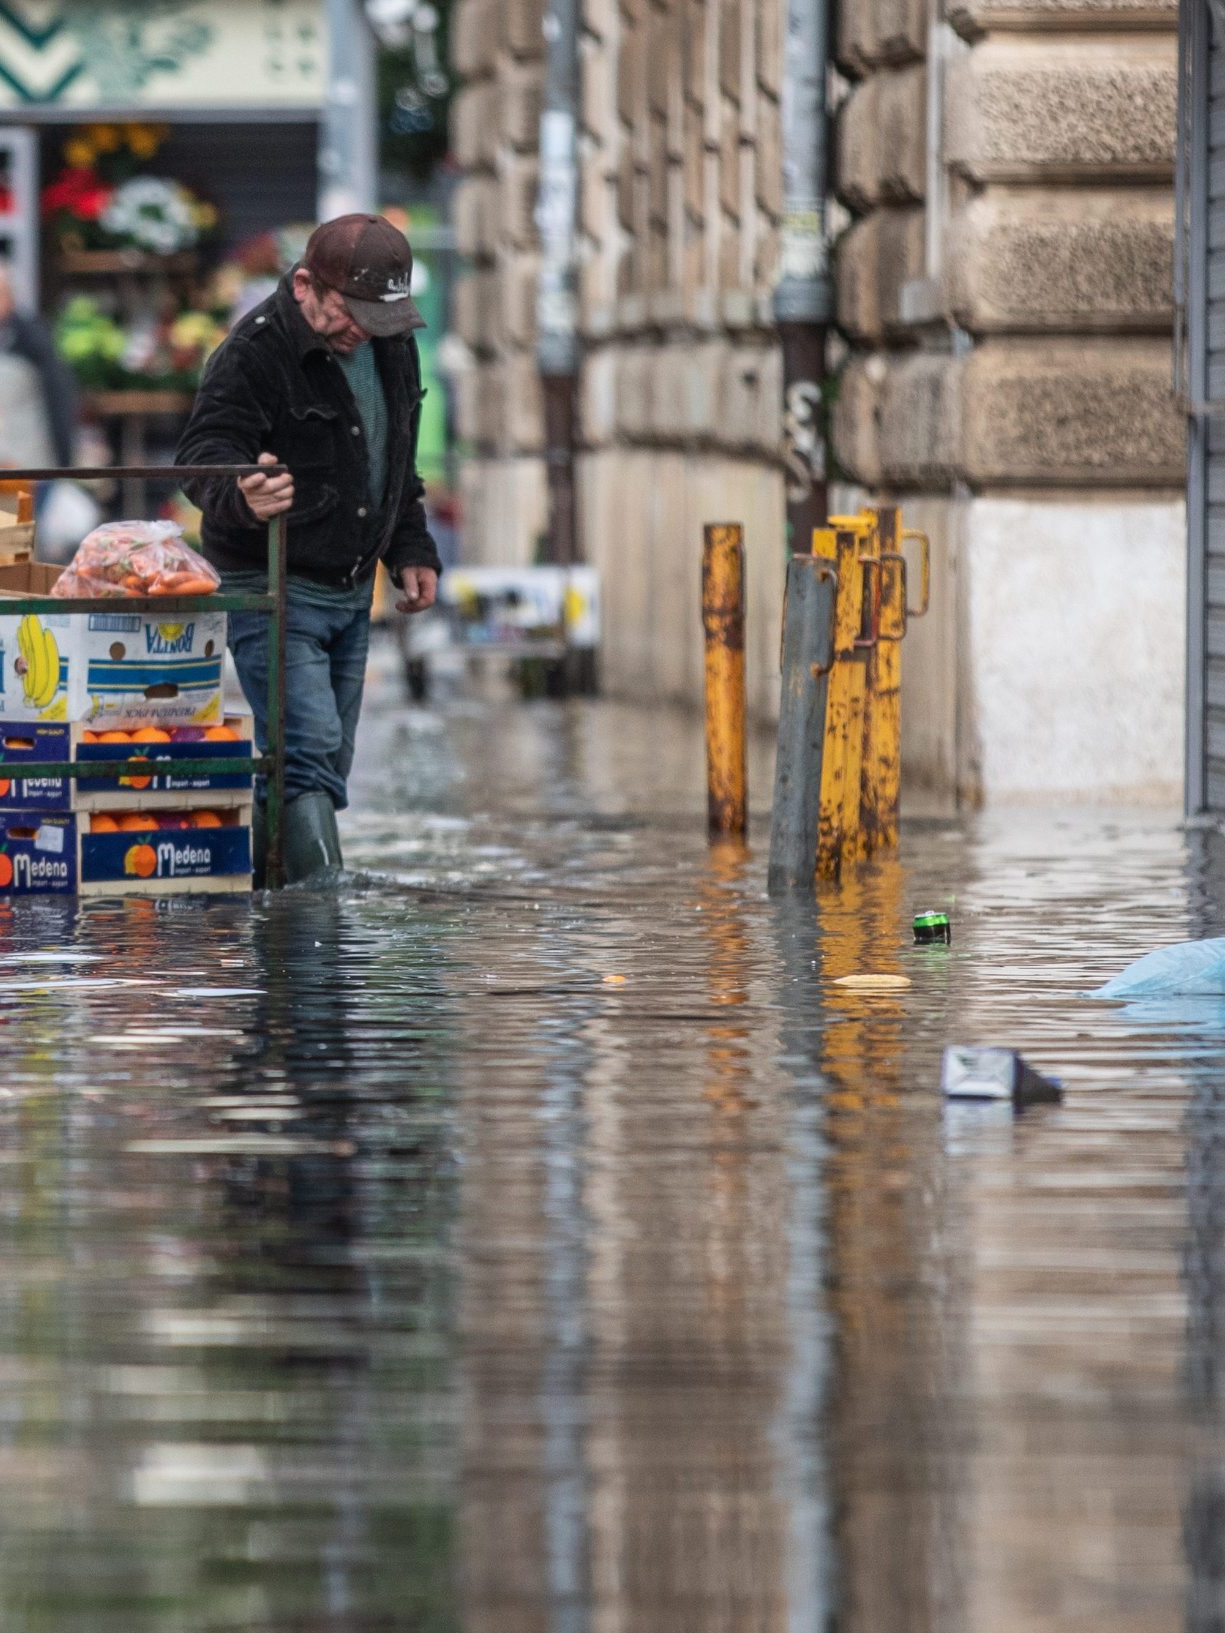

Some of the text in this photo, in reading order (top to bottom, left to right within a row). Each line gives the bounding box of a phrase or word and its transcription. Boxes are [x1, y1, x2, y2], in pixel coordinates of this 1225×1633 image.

[145, 622, 195, 654] BONITA
[14, 853, 68, 888] Medena
[157, 842, 211, 876] Medena
